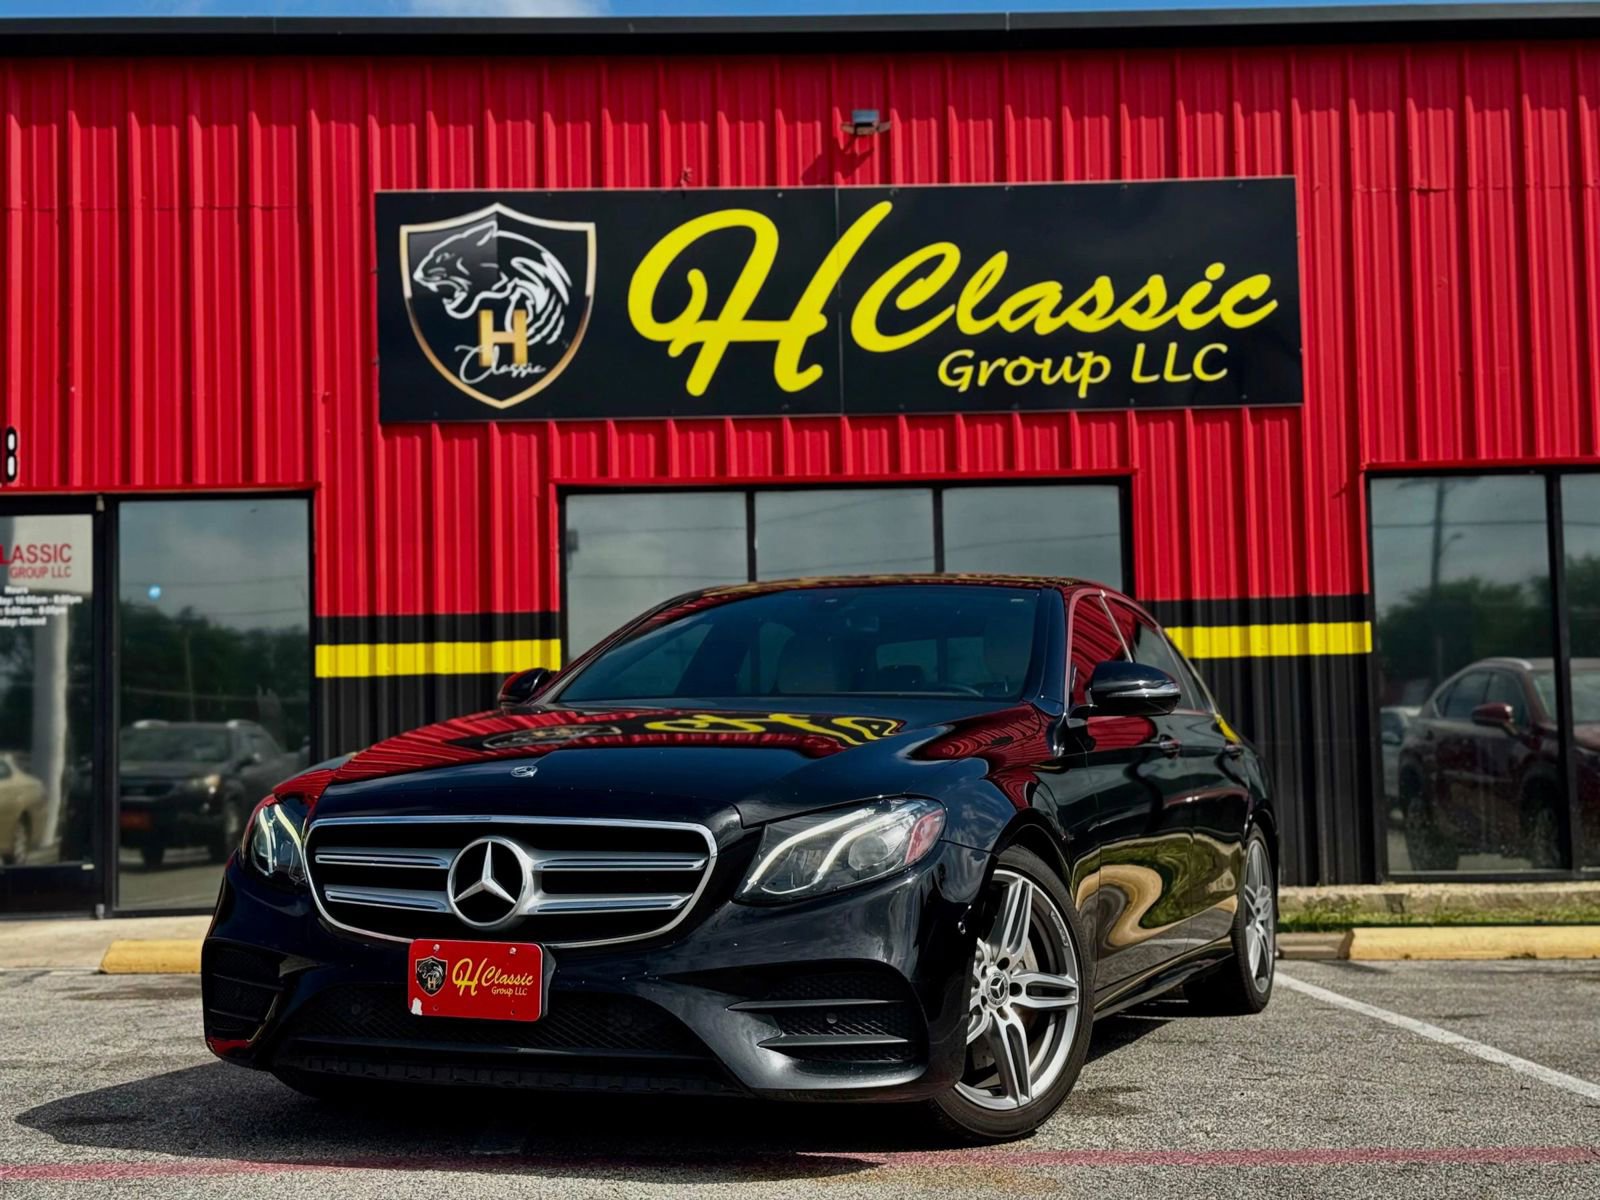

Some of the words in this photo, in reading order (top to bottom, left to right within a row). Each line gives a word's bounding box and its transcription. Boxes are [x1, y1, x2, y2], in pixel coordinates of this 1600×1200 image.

[628, 200, 892, 397] H
[850, 241, 1279, 353] Classic
[478, 309, 528, 367] H
[454, 344, 547, 384] Classic
[937, 350, 1111, 398] Group
[1131, 342, 1228, 383] LLC
[9, 566, 49, 579] GROUP
[51, 566, 72, 579] LLC
[452, 957, 488, 997] H
[481, 965, 534, 987] Classic
[491, 986, 514, 997] Group
[515, 987, 528, 996] LLC
